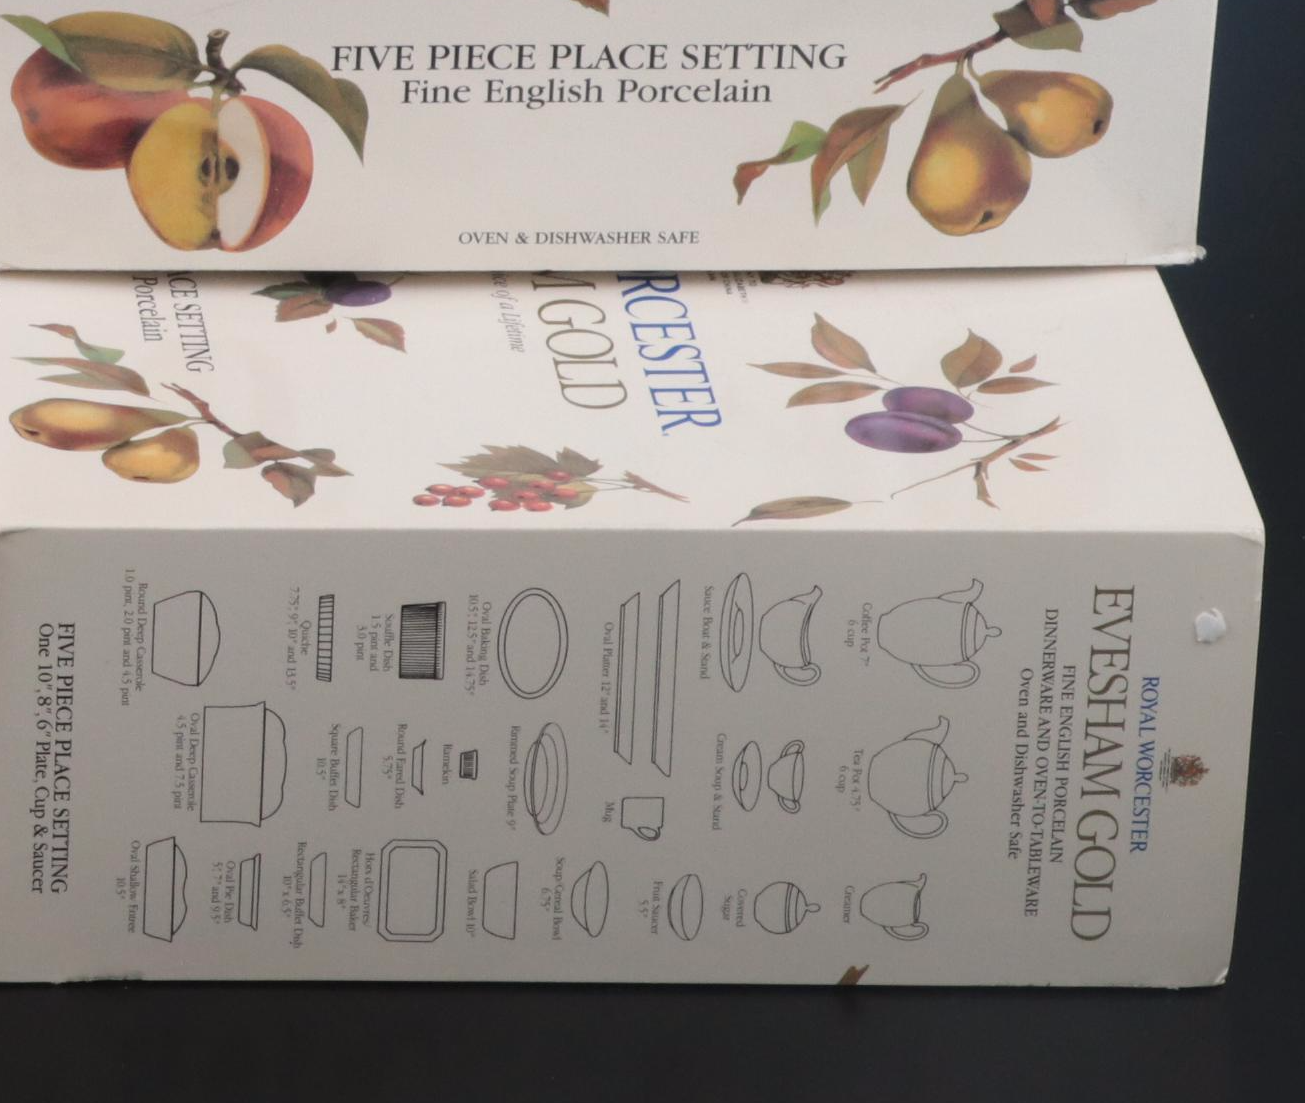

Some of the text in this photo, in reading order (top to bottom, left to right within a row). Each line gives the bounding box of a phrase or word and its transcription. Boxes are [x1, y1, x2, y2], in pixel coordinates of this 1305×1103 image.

[332, 43, 846, 71] FIVE PIECE PLACE SETTING
[403, 78, 771, 110] Fine English Porcelain
[458, 231, 699, 245] OVEN & DISHWASHER SAFE
[132, 276, 168, 343] Porcelain
[173, 303, 215, 373] SETTING
[537, 298, 628, 410] GOLD
[50, 623, 75, 894] FIVE PIECE PLACE SETTING
[1070, 585, 1135, 942] EVESHAM GOLD
[1129, 677, 1160, 853] ROYAL WORCESTER
